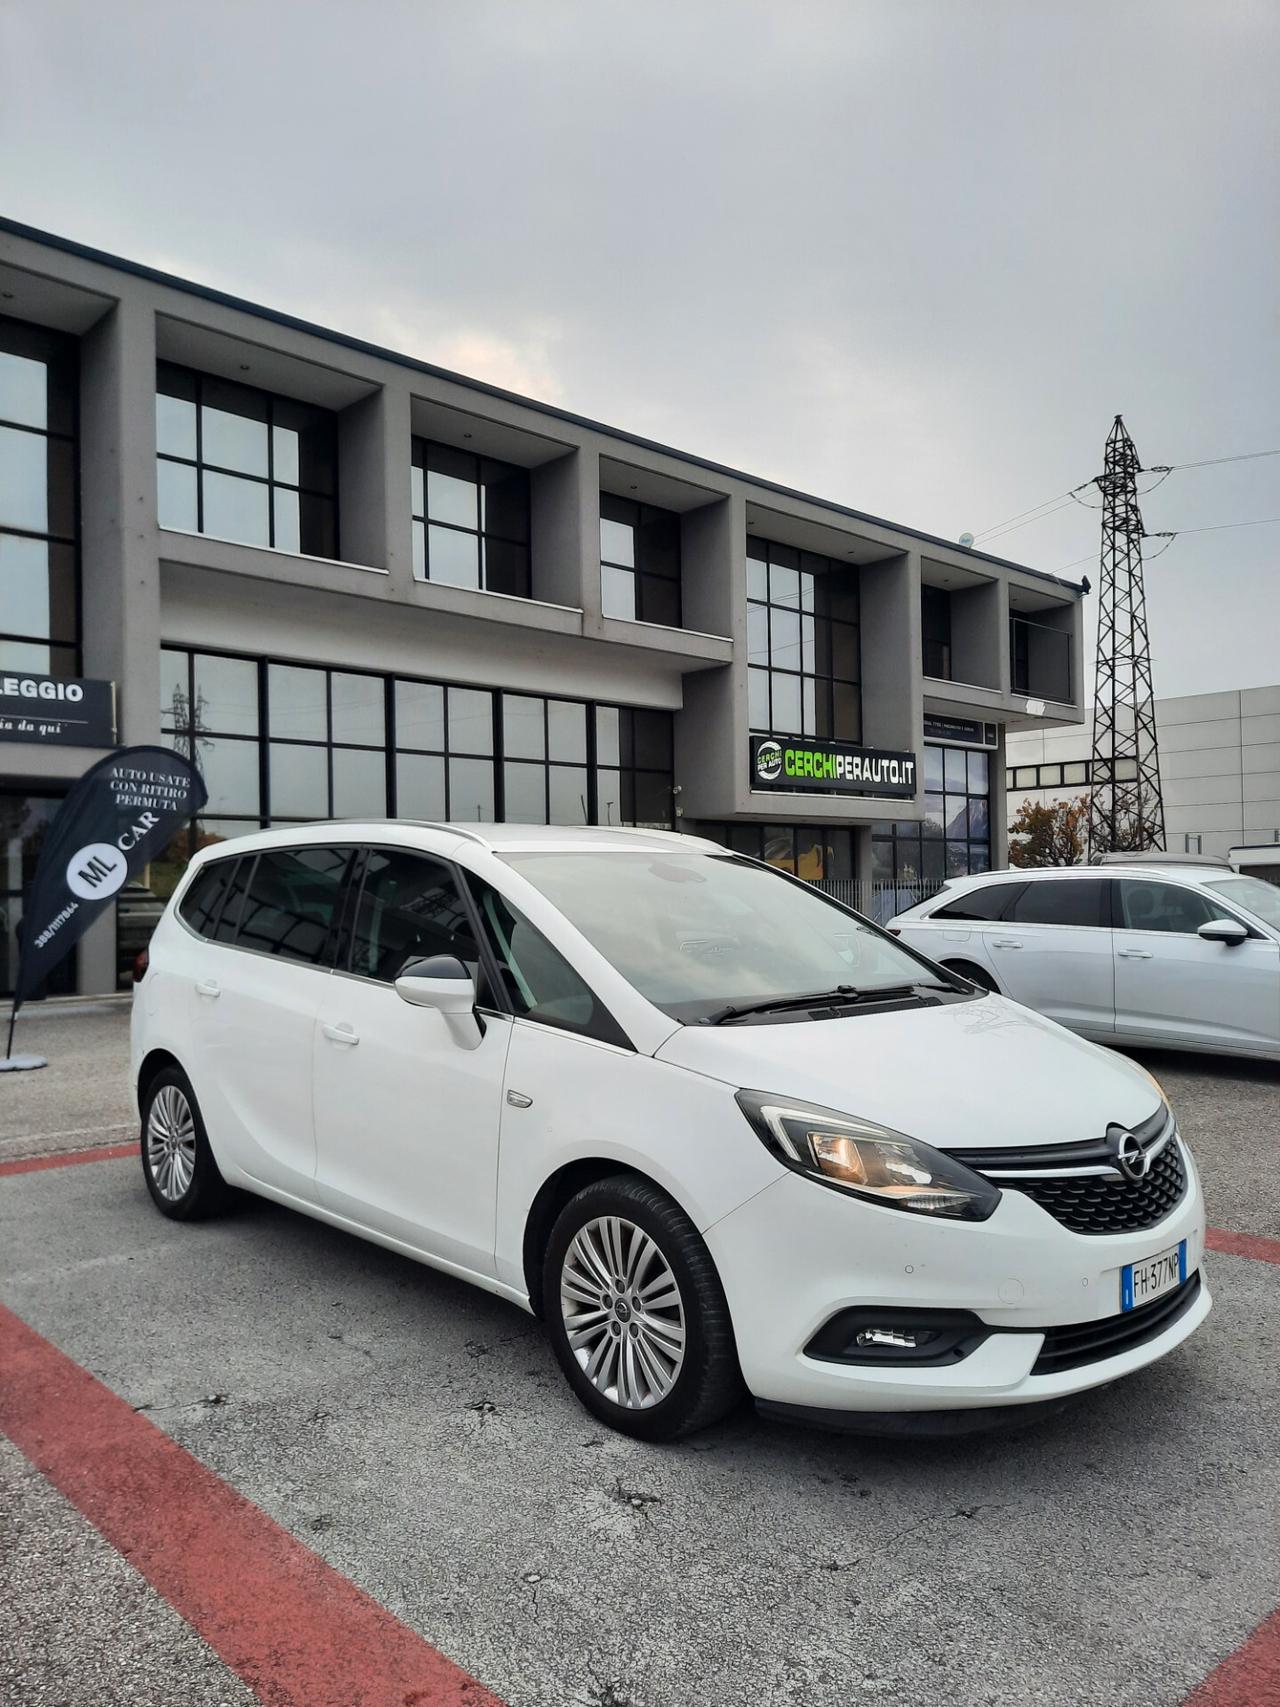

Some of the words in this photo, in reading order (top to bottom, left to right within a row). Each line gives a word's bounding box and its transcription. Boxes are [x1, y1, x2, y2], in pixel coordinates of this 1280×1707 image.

[0, 677, 84, 702] EGGIO
[18, 719, 34, 732] da
[39, 722, 62, 736] qui
[110, 767, 147, 780] AUTO
[149, 772, 191, 788] USATE
[110, 780, 137, 793] CON
[141, 784, 187, 799] RITIRO
[115, 793, 177, 811] PERMUTA
[118, 811, 160, 851] CAR
[77, 856, 118, 888] ML
